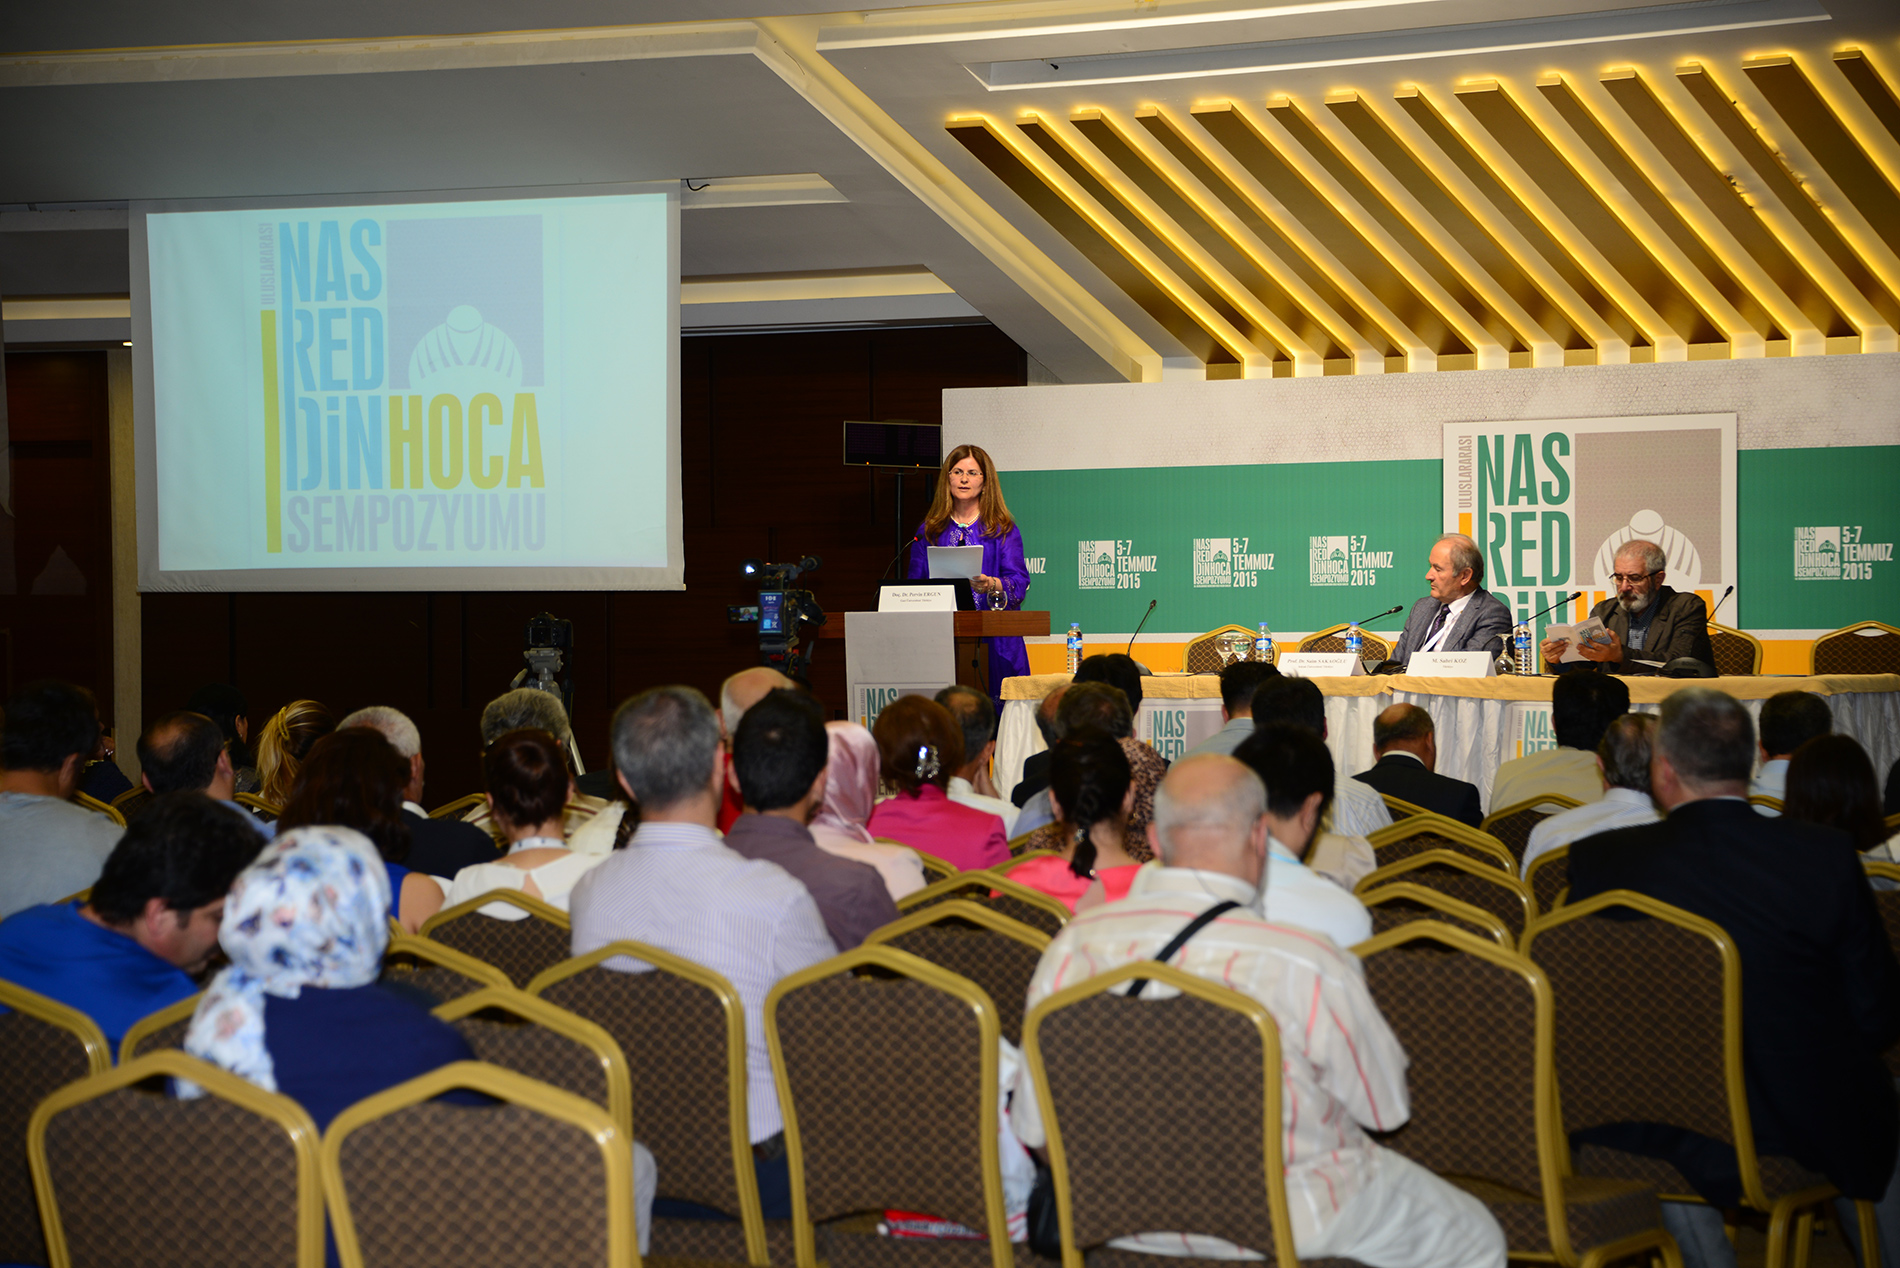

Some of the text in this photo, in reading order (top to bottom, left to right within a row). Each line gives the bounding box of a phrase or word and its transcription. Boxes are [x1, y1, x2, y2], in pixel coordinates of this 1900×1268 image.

[258, 222, 276, 305] ULUSLARARASI
[279, 218, 383, 303] NAS
[281, 306, 385, 392] RED
[1458, 435, 1472, 509] ULUSLARARASI
[1477, 432, 1570, 506] NAS
[287, 493, 547, 553] SEMPOZYUMU
[1350, 535, 1367, 551] 5-7
[1842, 526, 1862, 543] 5-7
[1116, 540, 1132, 555] 5-7
[1233, 538, 1249, 553] 5-7
[1478, 511, 1571, 587] RED
[1842, 543, 1893, 561] TEMMUZ
[1024, 557, 1047, 574] MUZ
[1116, 555, 1157, 572] TEMMUZ
[1233, 553, 1274, 570] TEMMUZ
[1350, 551, 1393, 568] TEMMUZ
[1233, 571, 1257, 587] 2015
[1350, 570, 1376, 586] 2015
[1842, 563, 1872, 580] 2015
[1117, 573, 1140, 589] 2015
[1153, 710, 1185, 738] NAS
